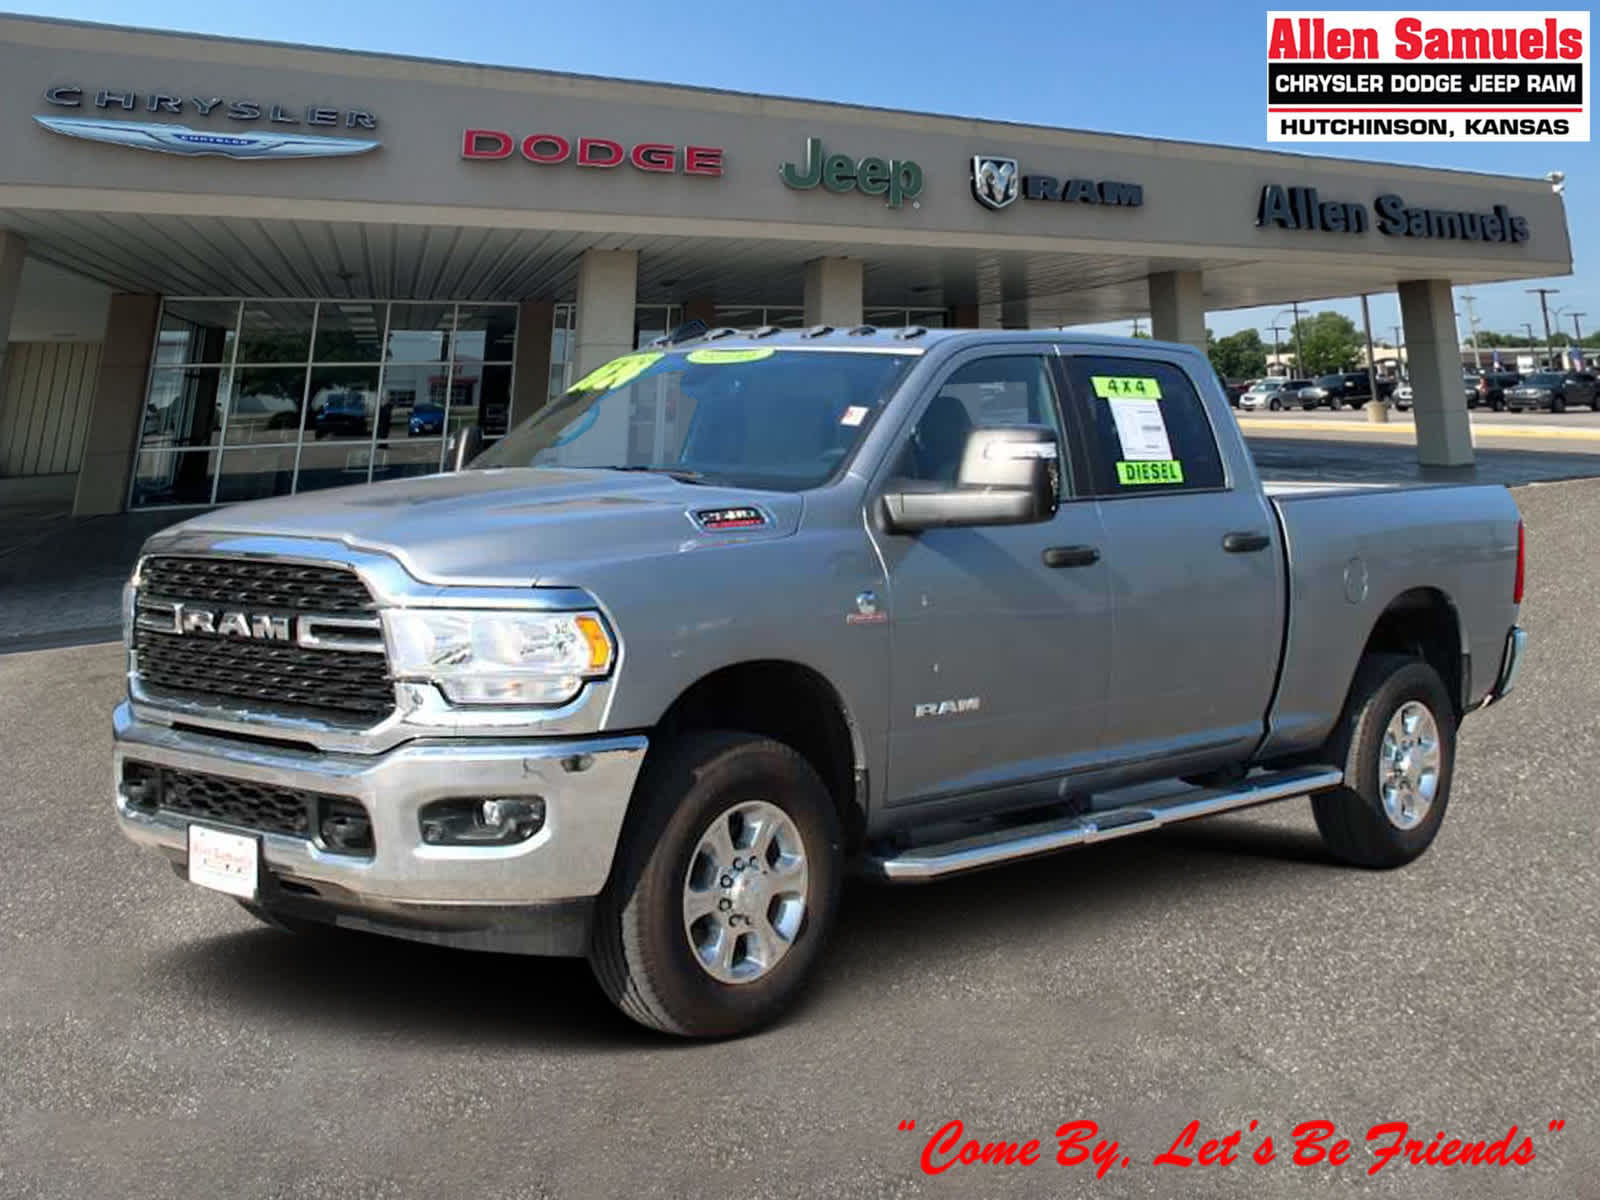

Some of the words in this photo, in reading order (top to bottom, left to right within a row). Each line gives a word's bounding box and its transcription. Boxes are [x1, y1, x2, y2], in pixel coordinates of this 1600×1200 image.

[44, 86, 378, 129] CHRYSLER
[462, 128, 724, 176] DODGE
[780, 136, 923, 208] Jeep
[1023, 174, 1144, 207] RAM
[1256, 184, 1370, 233] Allen
[1374, 194, 1531, 243] Samuels
[1125, 463, 1177, 480] DIESEL
[183, 609, 290, 641] RAM
[914, 697, 981, 718] RAM
